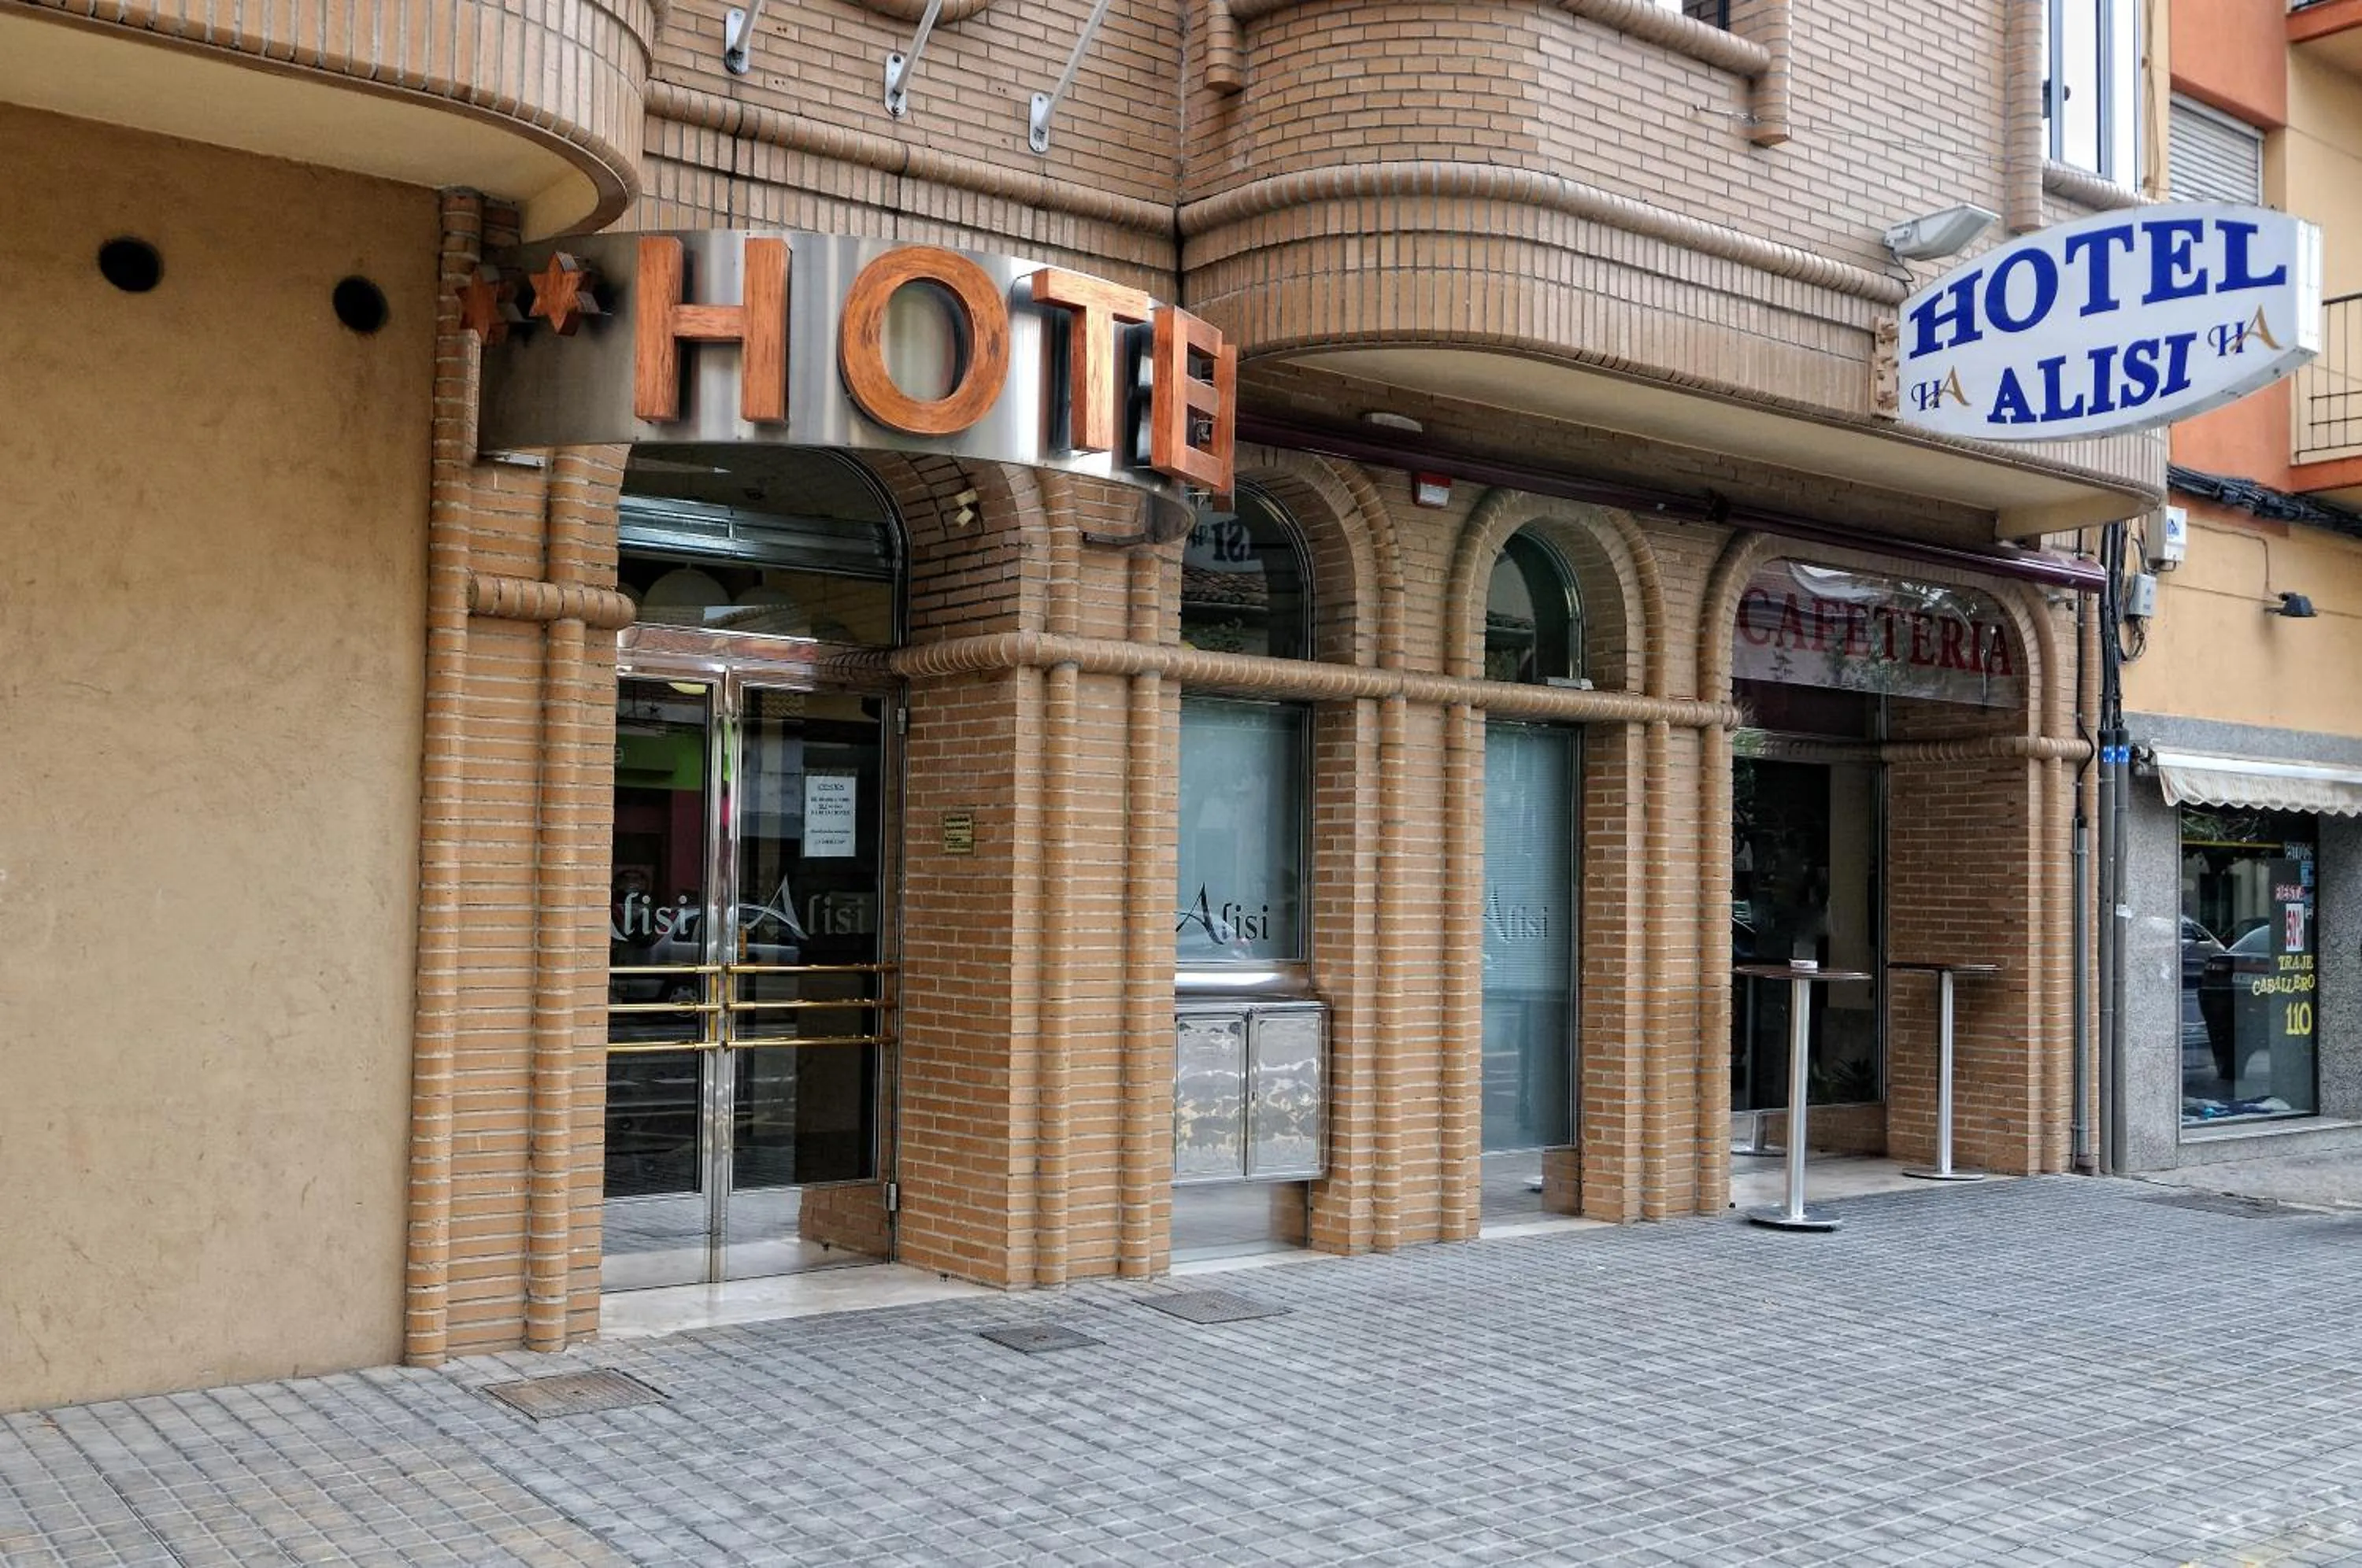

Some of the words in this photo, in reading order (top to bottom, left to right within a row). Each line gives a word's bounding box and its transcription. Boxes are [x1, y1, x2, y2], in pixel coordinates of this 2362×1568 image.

[1909, 219, 2286, 360] HOTEL
[633, 236, 1238, 502] HOTE
[1986, 331, 2197, 424] ALISI
[1737, 586, 2013, 677] CAFETERIA
[2253, 974, 2316, 996] CABALLERO
[2278, 955, 2314, 971] TRAJE
[2286, 1002, 2312, 1035] 110
